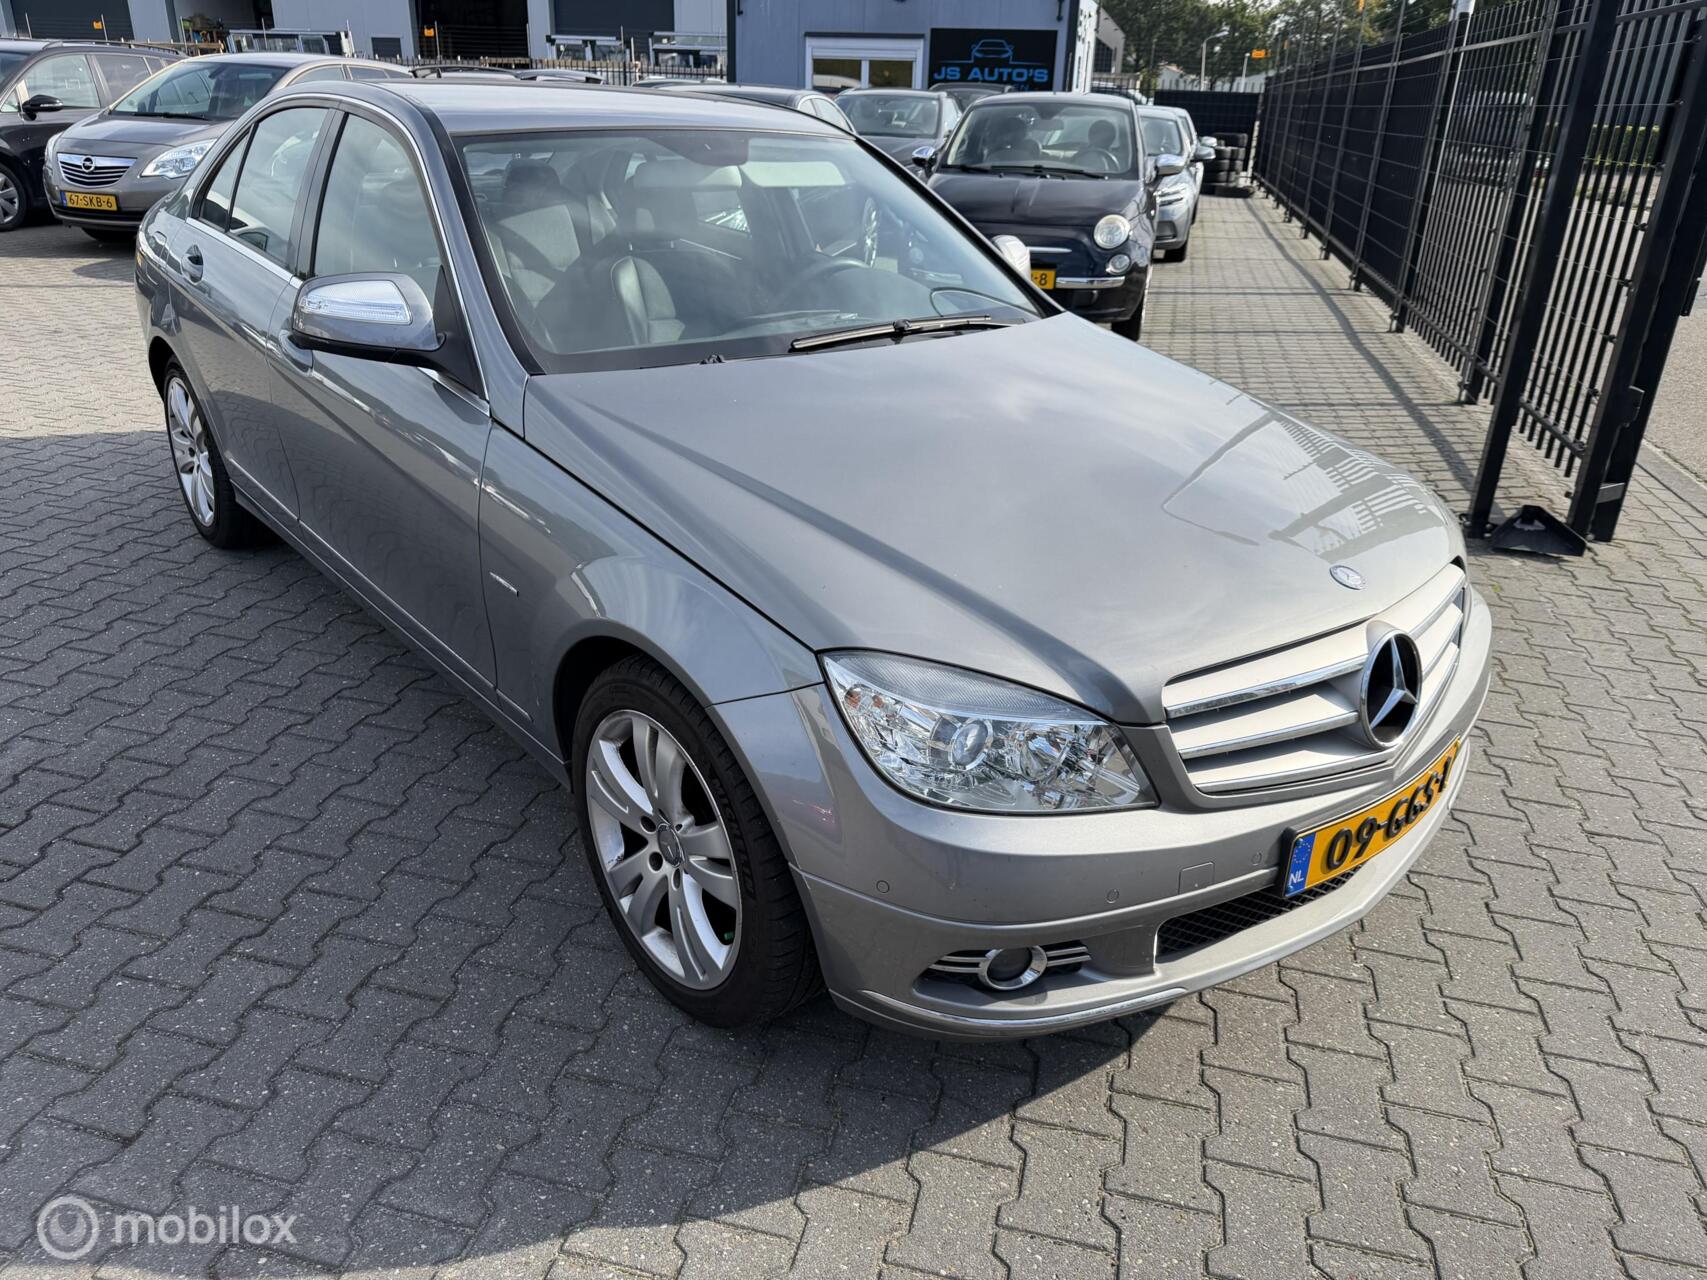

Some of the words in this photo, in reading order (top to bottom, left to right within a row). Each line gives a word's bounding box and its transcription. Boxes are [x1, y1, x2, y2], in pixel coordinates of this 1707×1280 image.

[933, 66, 961, 80] JS
[967, 67, 1049, 83] AUTO'S
[69, 194, 113, 209] 67-SKB-6
[1289, 870, 1304, 885] NL
